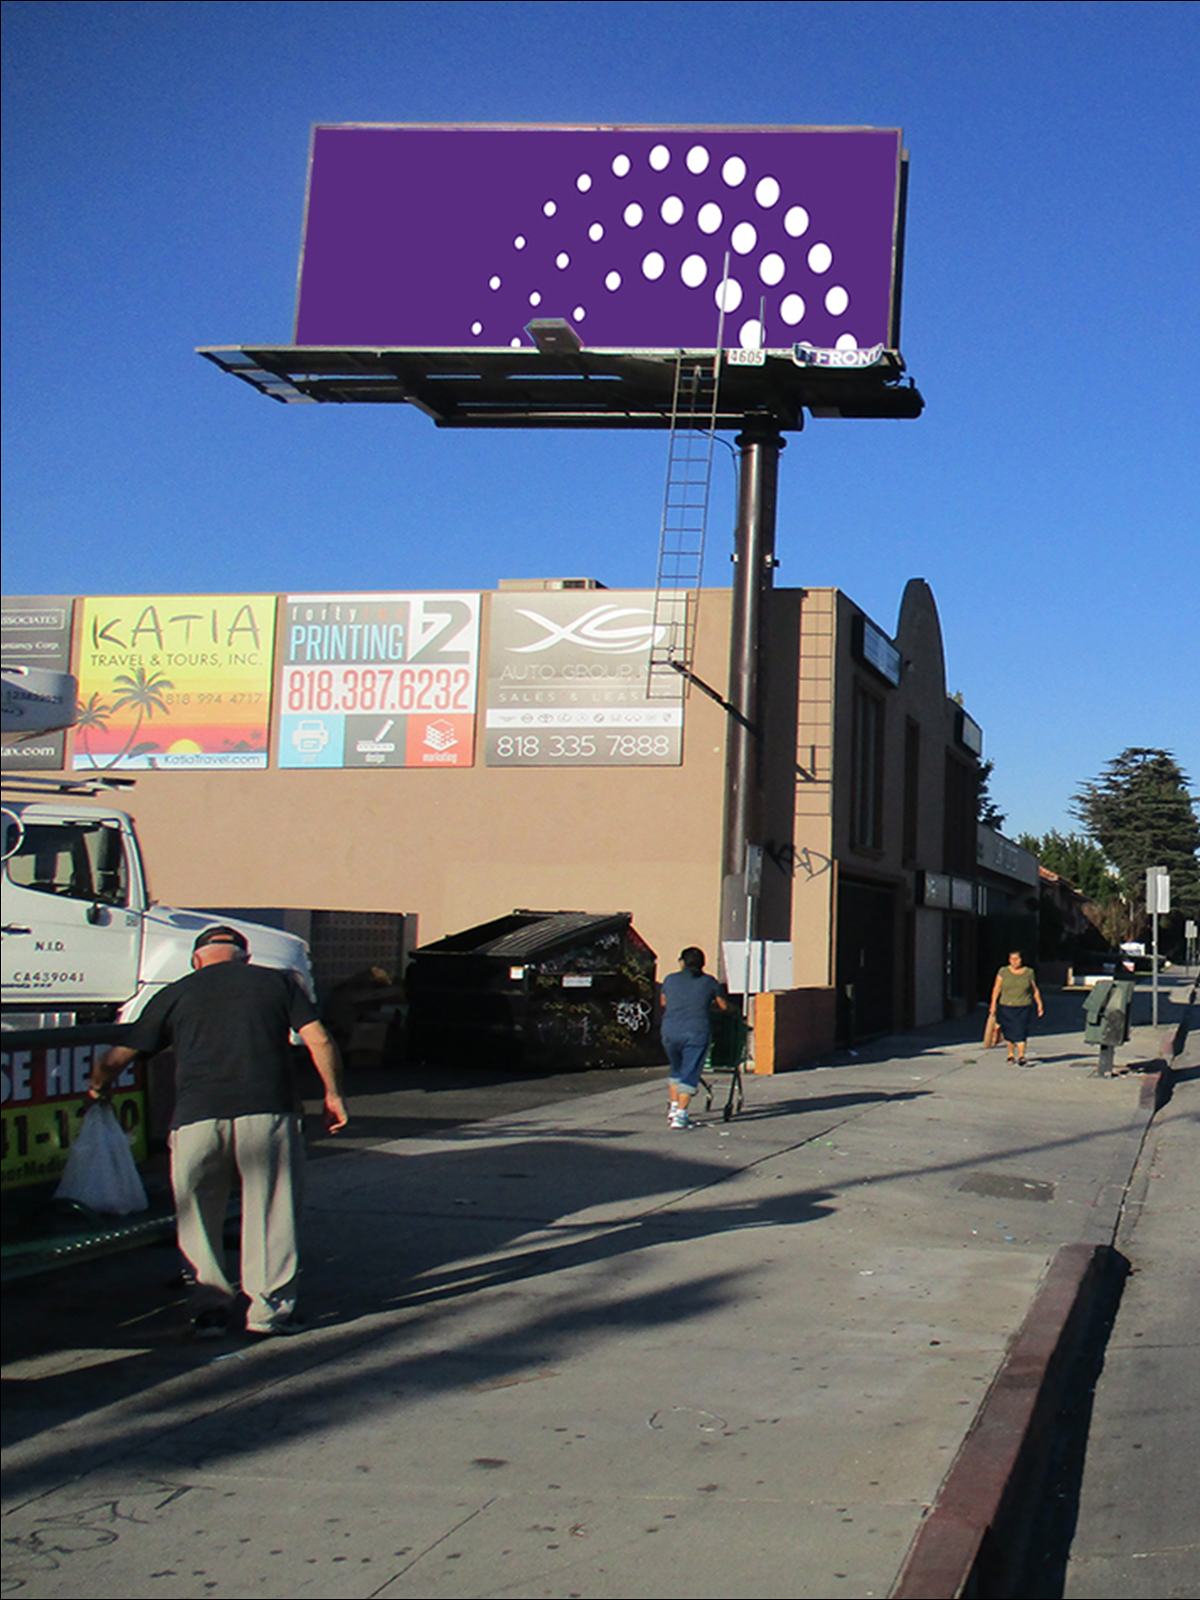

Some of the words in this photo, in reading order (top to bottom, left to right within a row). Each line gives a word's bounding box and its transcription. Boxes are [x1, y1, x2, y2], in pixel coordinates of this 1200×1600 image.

[729, 350, 763, 364] 4605
[93, 604, 260, 650] KATIA
[289, 624, 404, 661] PRINTING
[90, 653, 144, 667] TRAVEL
[150, 654, 160, 667] &
[167, 653, 223, 667] TOURS,
[228, 653, 263, 667] INC.
[500, 664, 556, 681] AUTO
[288, 668, 471, 711] 818.387.6232
[500, 691, 556, 703] SALES
[165, 693, 190, 705] 818
[197, 693, 223, 705] 994
[229, 693, 263, 705] 4717
[497, 735, 540, 757] 818
[549, 735, 597, 757] 335
[606, 735, 670, 757] 7888
